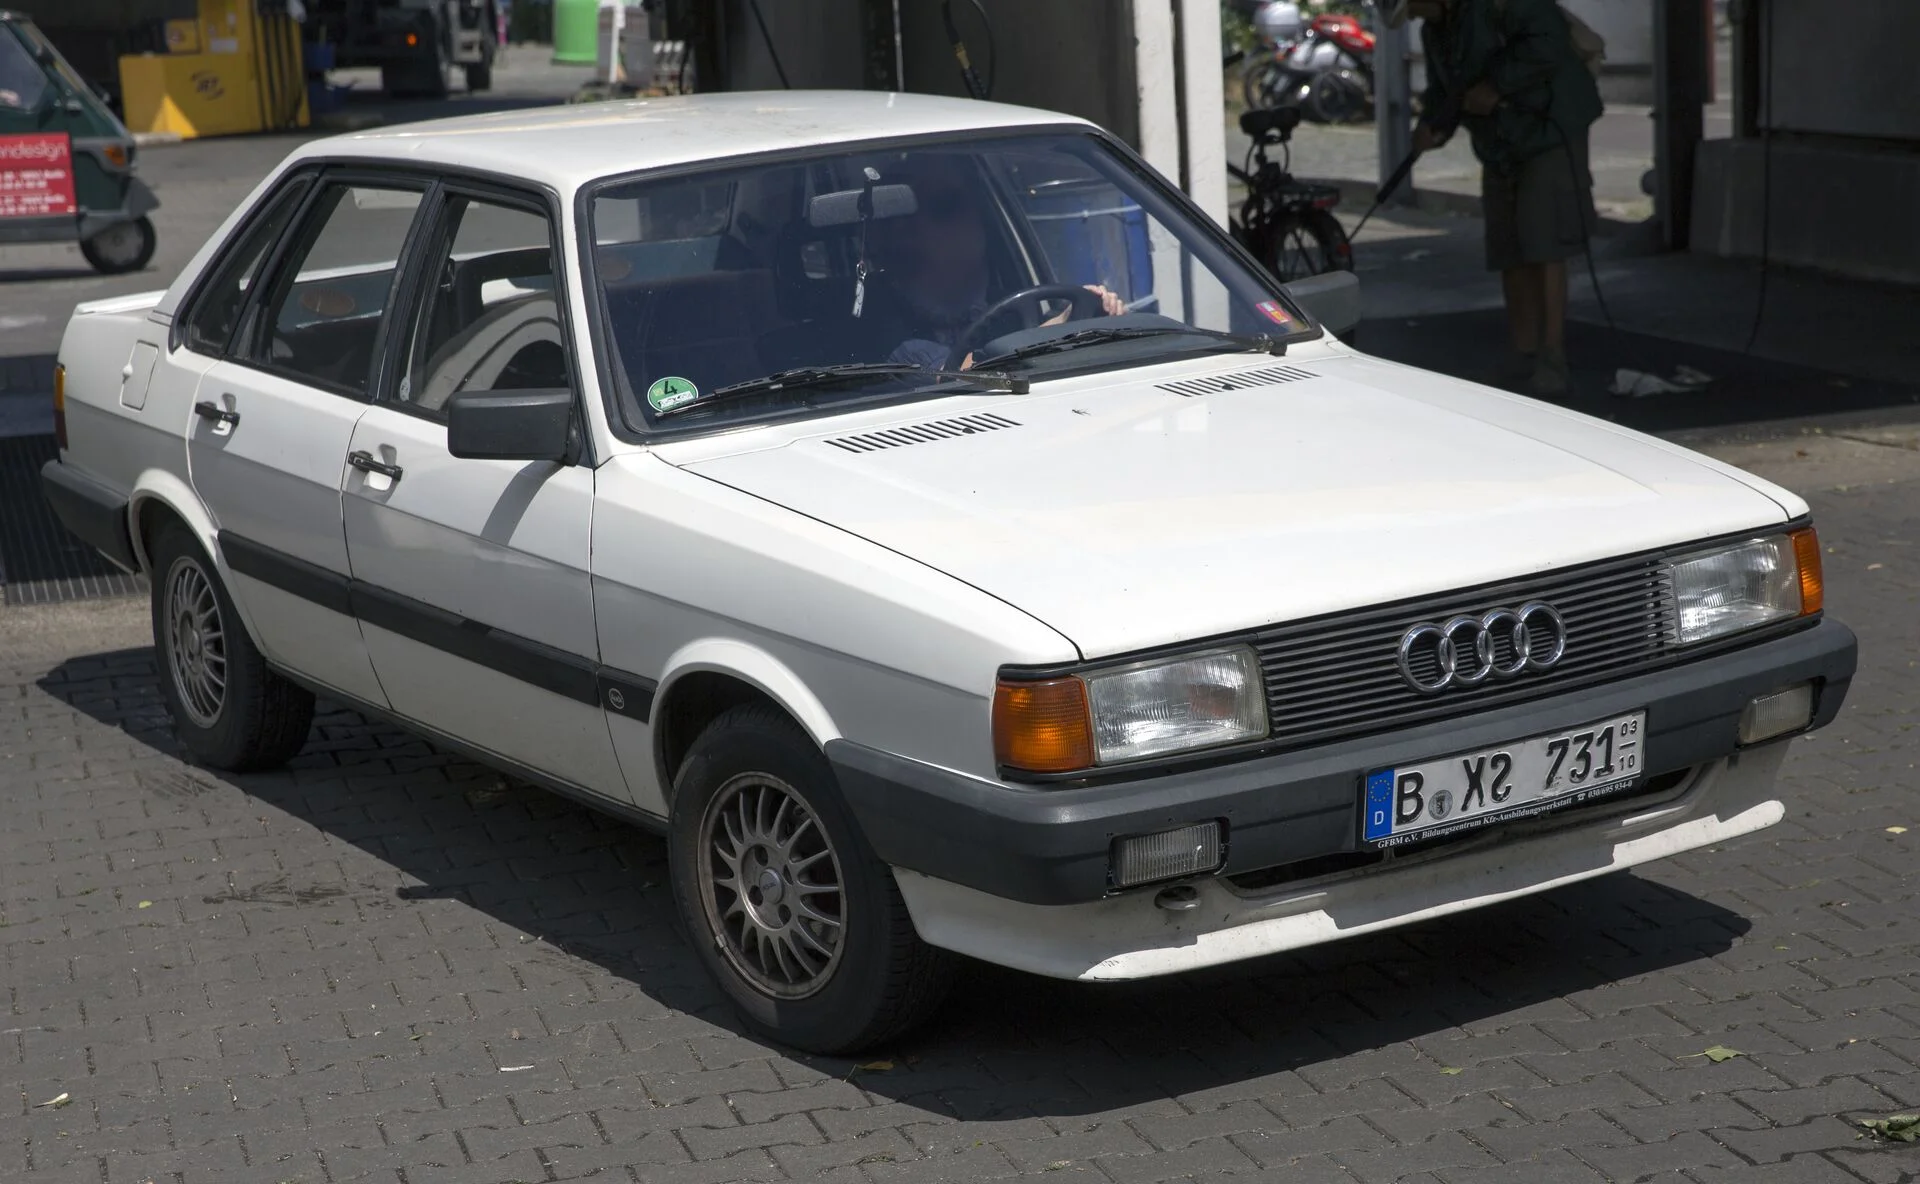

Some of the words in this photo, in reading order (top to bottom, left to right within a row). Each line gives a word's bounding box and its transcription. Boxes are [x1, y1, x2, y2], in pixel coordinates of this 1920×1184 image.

[664, 379, 678, 394] 4
[1620, 718, 1638, 736] 03
[1619, 753, 1635, 771] 10
[1395, 771, 1424, 826] B
[1544, 725, 1615, 790] 731
[1374, 810, 1384, 826] D
[1377, 836, 1404, 850] GFBM
[1404, 832, 1418, 844] e.V.
[1422, 819, 1482, 839] Bildungszentrum
[1483, 797, 1572, 825] Kfz-Ausbildungswerkstatt
[1587, 785, 1613, 799] 030/695
[1614, 779, 1633, 792] 934-0
